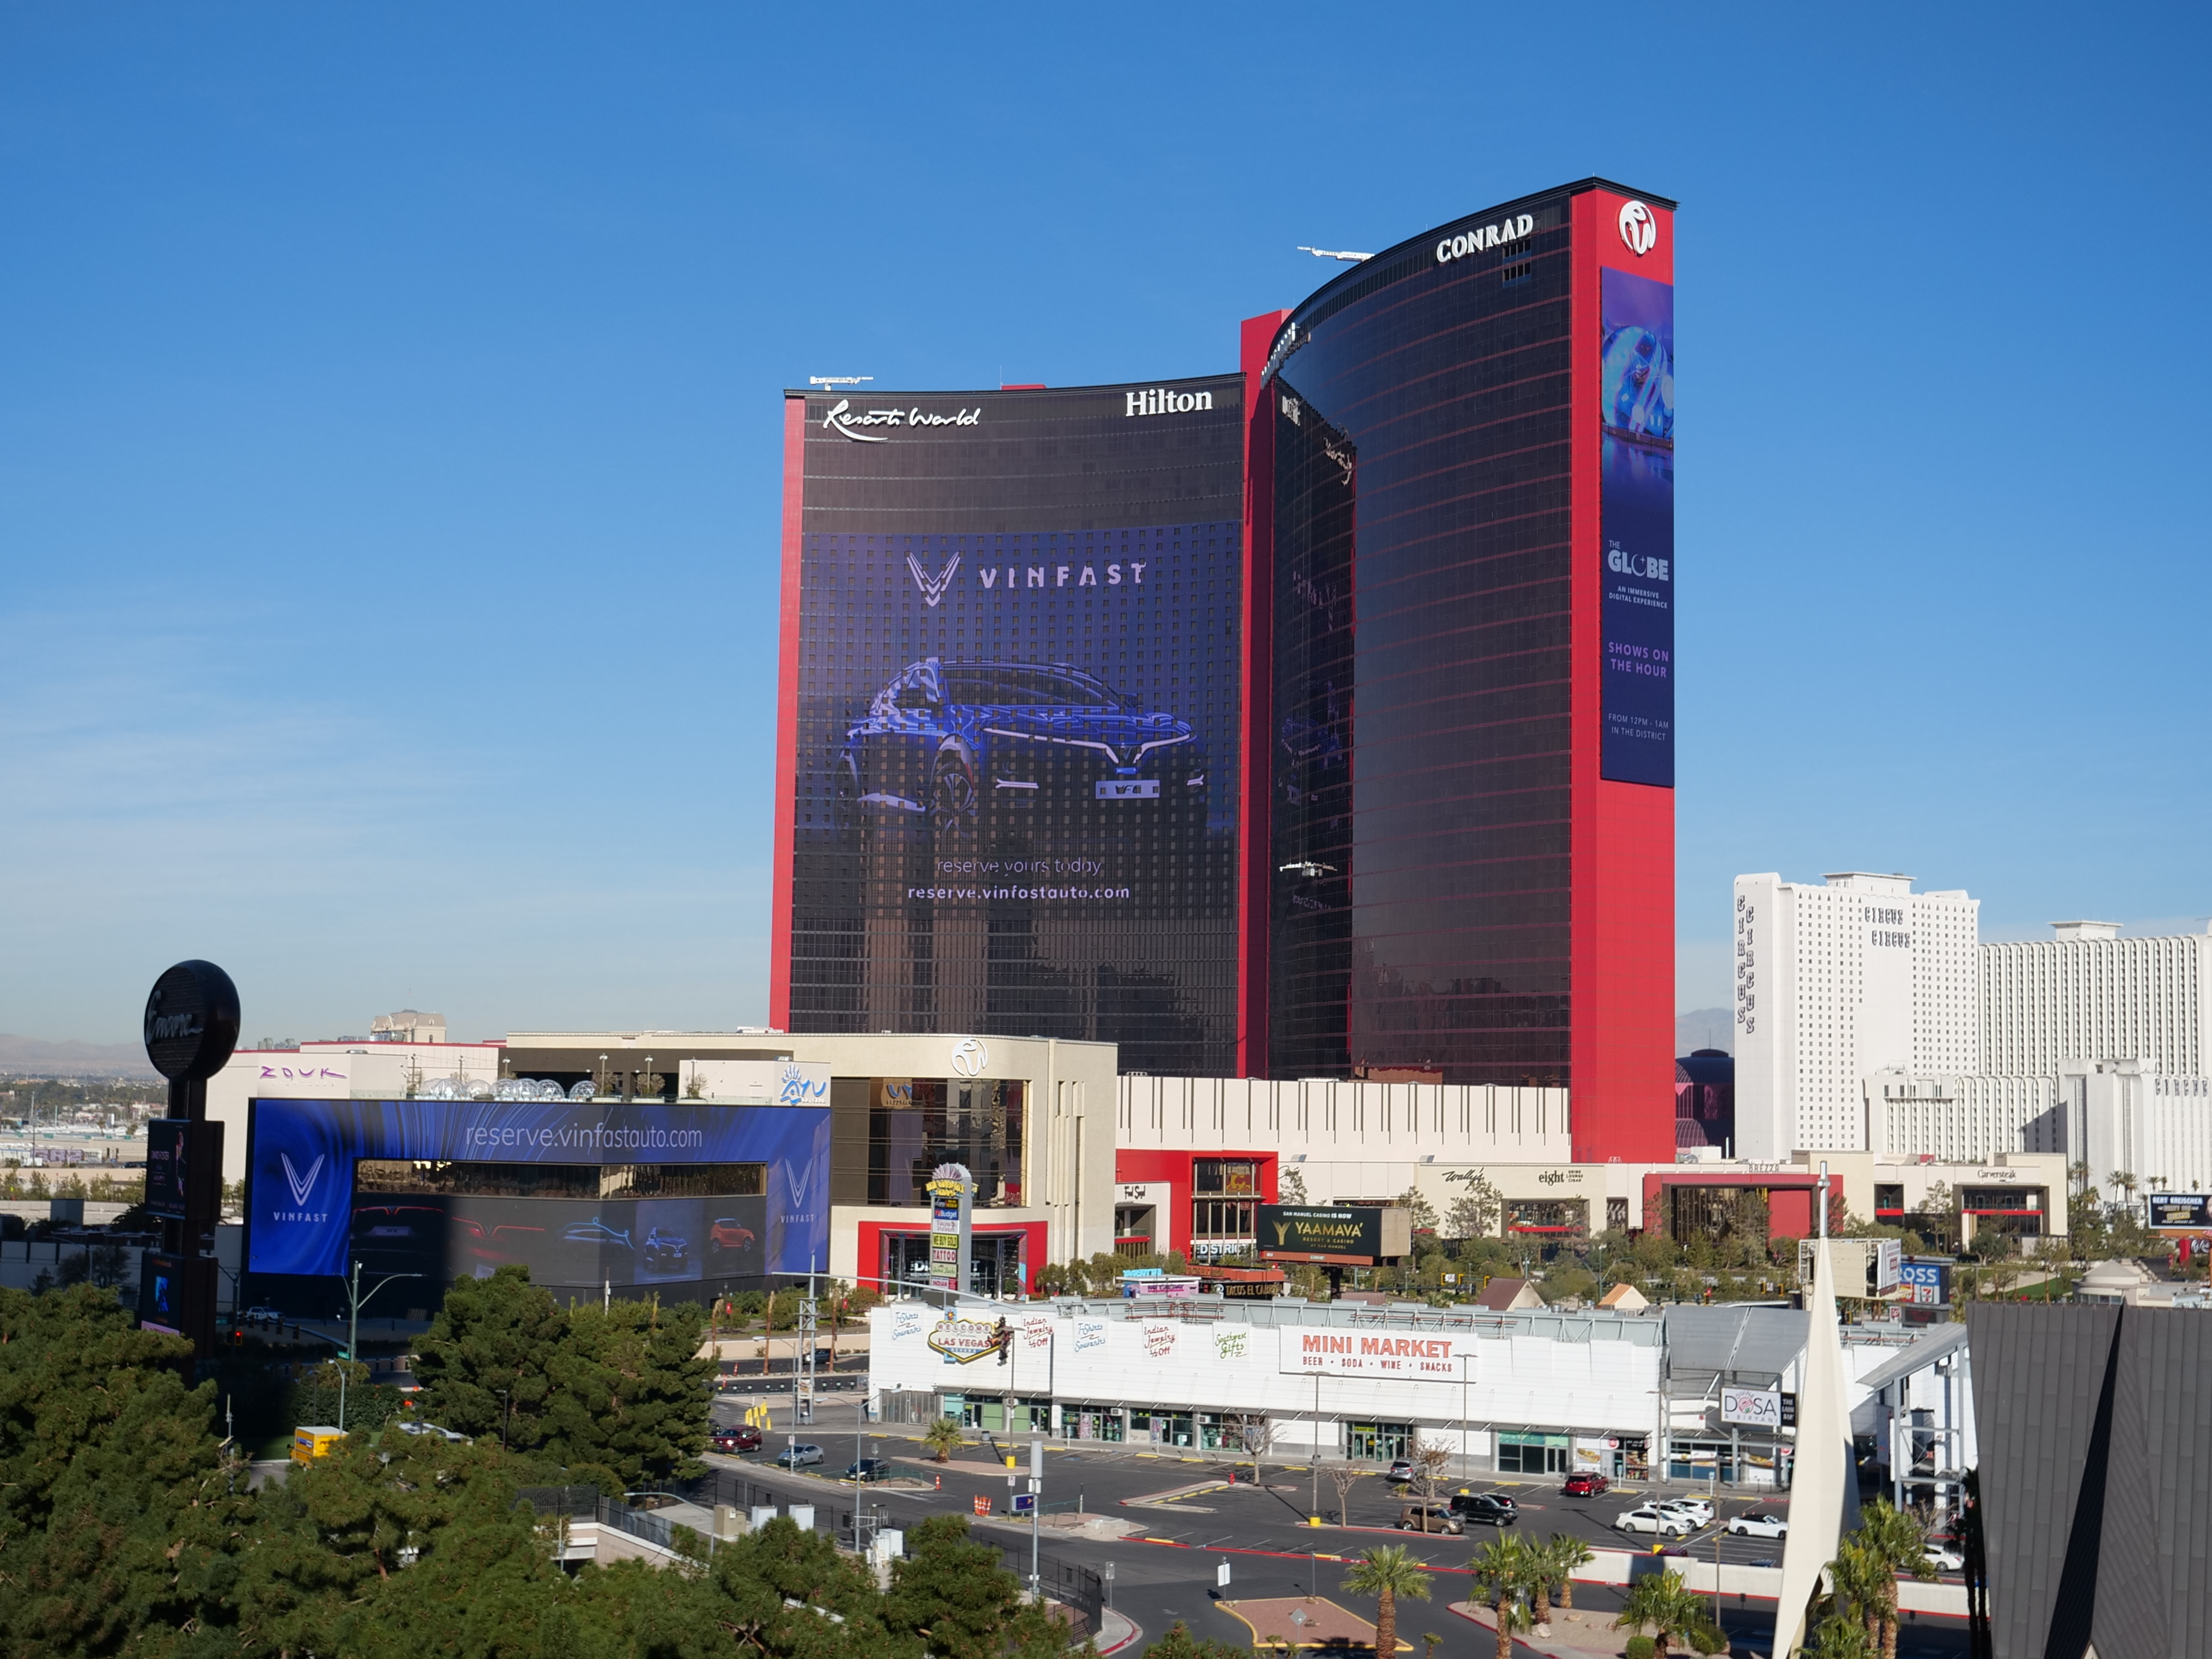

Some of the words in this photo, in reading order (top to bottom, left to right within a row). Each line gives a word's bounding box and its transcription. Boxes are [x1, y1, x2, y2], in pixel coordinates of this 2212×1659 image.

[1436, 214, 1534, 263] CONRAD
[1126, 388, 1212, 417] Hilton
[823, 400, 905, 441] Resorts
[909, 407, 980, 426] World
[1609, 540, 1621, 549] THE
[1608, 549, 1669, 581] GLOBE
[979, 561, 1147, 588] VINFAST
[1609, 592, 1631, 602] DIGITAL
[1633, 596, 1667, 609] EXPERIENCE
[1628, 587, 1659, 599] IMMERSIVE
[1609, 641, 1648, 658] SHOWS
[1653, 649, 1669, 662] ON
[1610, 659, 1631, 672] THE
[1636, 662, 1667, 678] HOUR
[1609, 713, 1628, 723] FROM
[1630, 716, 1648, 726] 12PM
[1655, 720, 1669, 729] 1AM
[1612, 726, 1619, 735] IN
[1621, 727, 1634, 736] THE
[1636, 730, 1666, 741] DISTRICT
[937, 860, 999, 872] reserve
[1054, 857, 1101, 876] today
[1865, 906, 1904, 924] CIRCUS
[1871, 930, 1910, 948] CIRCUS
[1737, 895, 1746, 1024] CIRCUS
[1746, 906, 1755, 1034] CIRCUS
[466, 1122, 703, 1147] reserve.vinfastauto.com
[1441, 1167, 1484, 1182] Wally's
[1539, 1170, 1565, 1186] eight
[273, 1212, 329, 1223] VINFAST
[780, 1213, 815, 1224] VINFAST
[941, 1210, 957, 1219] Budget
[933, 1250, 956, 1260] TATTOO
[1200, 1244, 1247, 1254] DSTRICT
[1226, 1285, 1246, 1296] TACOS
[1247, 1285, 1255, 1295] EL
[938, 1323, 990, 1332] WELCOME
[1023, 1316, 1047, 1327] Indian
[1024, 1327, 1053, 1339] Jewelry
[1144, 1325, 1169, 1335] Indian
[959, 1339, 990, 1348] VEGAS
[1144, 1332, 1176, 1348] Jewelry
[1215, 1331, 1247, 1346] Southwest
[1303, 1334, 1352, 1353] MINI
[1361, 1337, 1452, 1358] MARKET
[1220, 1342, 1244, 1358] Gifts
[1303, 1356, 1322, 1366] BEER
[1342, 1358, 1363, 1367] SODA
[1381, 1360, 1401, 1369] WINE
[1420, 1361, 1452, 1372] SNACKS
[1725, 1395, 1777, 1416] DOSA
[1737, 1414, 1778, 1423] BIRYANI
